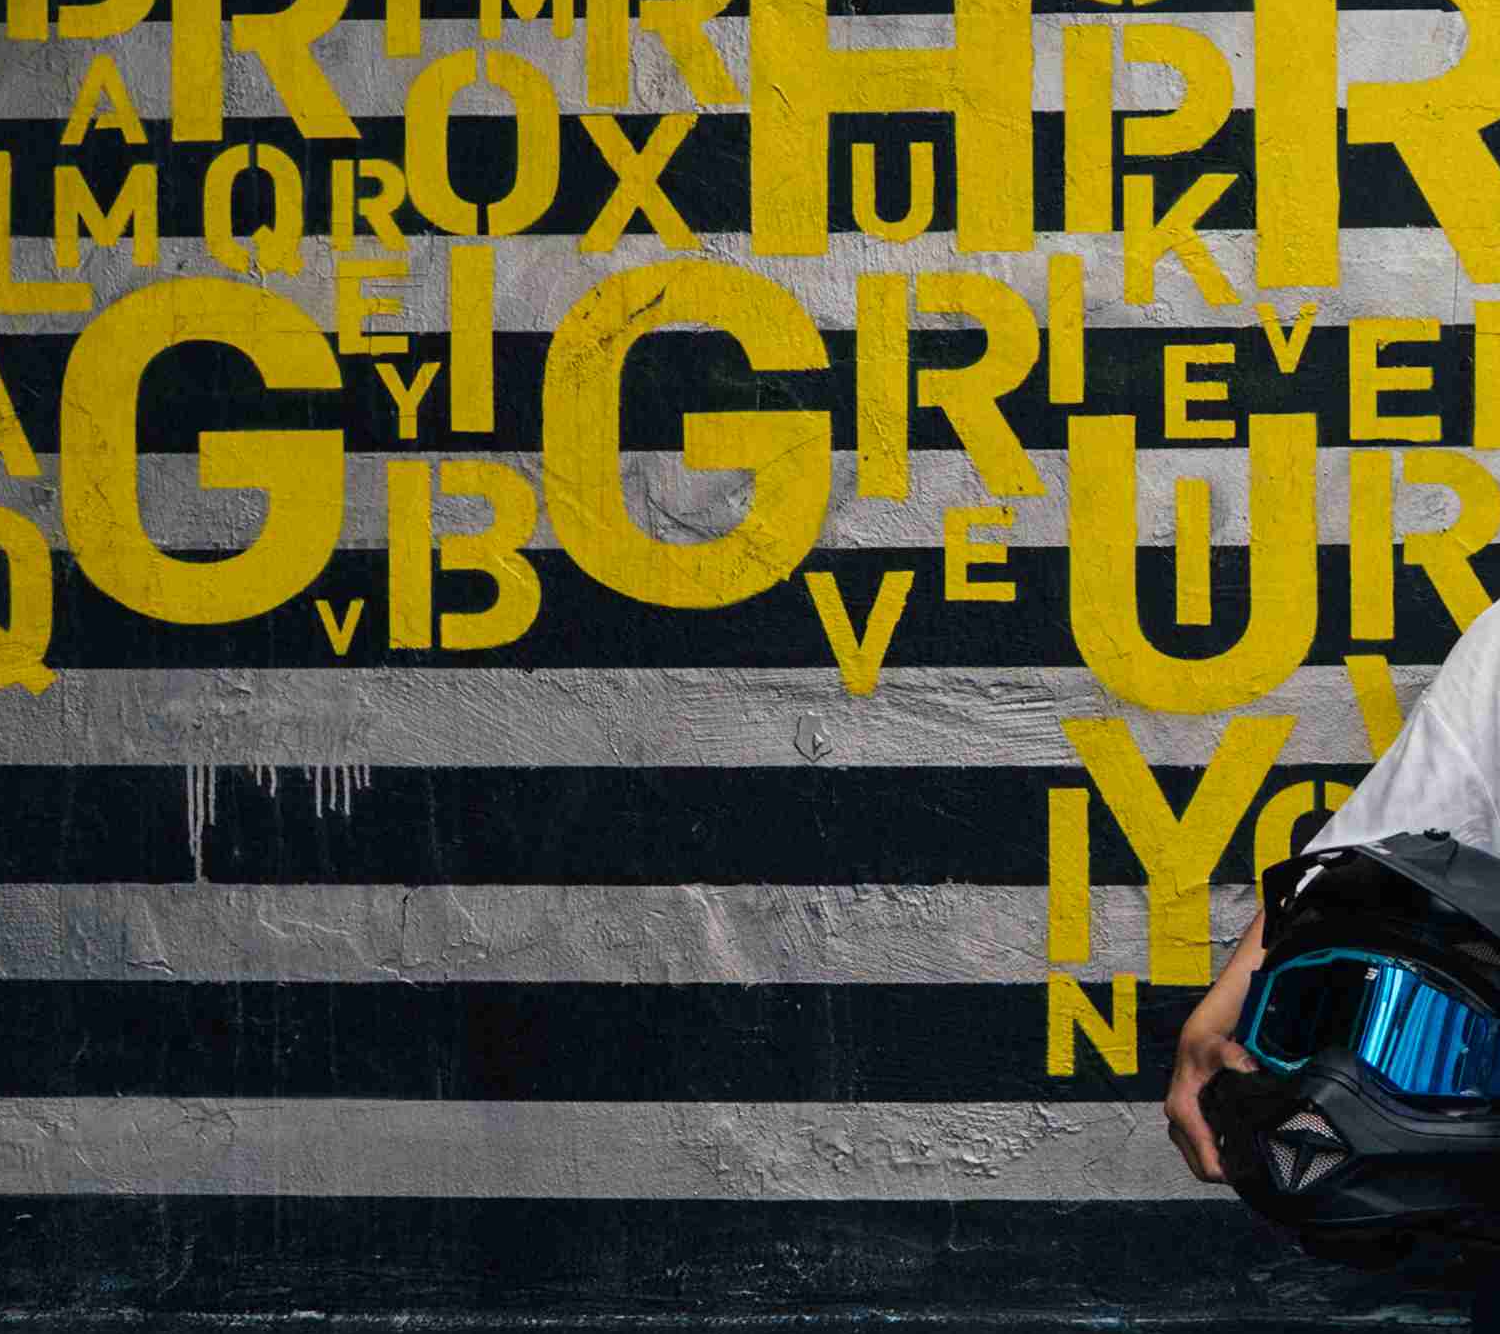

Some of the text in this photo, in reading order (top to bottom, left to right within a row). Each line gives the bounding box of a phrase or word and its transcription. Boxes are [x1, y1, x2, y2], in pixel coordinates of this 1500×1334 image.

[54, 164, 159, 268] M
[203, 144, 304, 277] Q
[331, 160, 411, 252] R
[405, 48, 560, 237] O
[577, 113, 702, 254] X
[852, 142, 935, 244] U
[1123, 173, 1241, 307] K
[61, 55, 148, 145] A
[1063, 24, 1234, 234] P
[58, 276, 345, 624] G
[335, 259, 409, 356] E
[856, 272, 1046, 502] R
[1164, 343, 1236, 439] E
[1256, 303, 1318, 373] V
[1348, 318, 1442, 442] E
[375, 363, 441, 439] Y
[542, 258, 832, 609] G
[316, 599, 364, 656] V
[805, 571, 914, 697] V
[944, 507, 1016, 602] E
[1068, 412, 1318, 715] U
[387, 459, 541, 650] B
[1061, 715, 1298, 986] Y
[1047, 971, 1138, 1076] N
